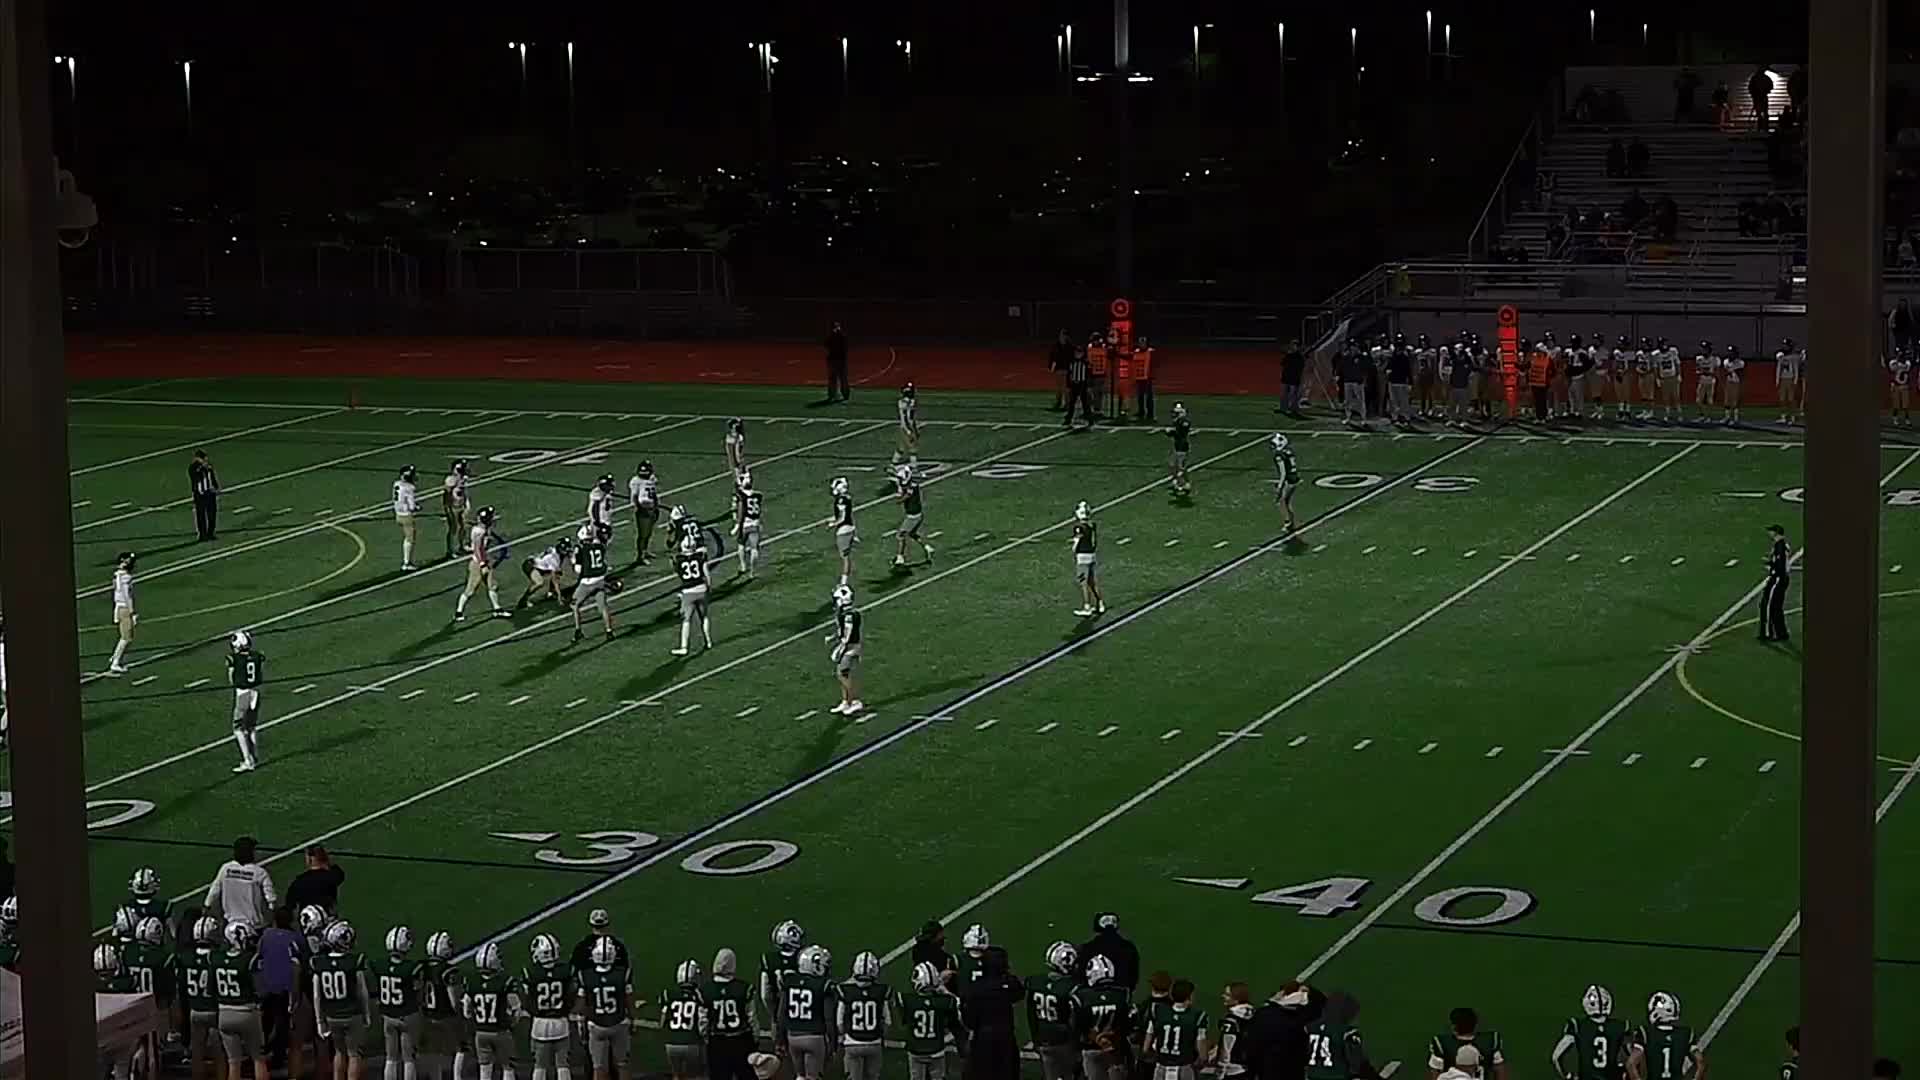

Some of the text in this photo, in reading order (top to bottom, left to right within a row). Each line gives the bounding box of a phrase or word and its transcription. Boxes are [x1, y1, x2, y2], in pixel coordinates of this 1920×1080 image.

[589, 549, 604, 569] 12
[681, 559, 701, 580] 33
[246, 662, 256, 683] 9
[1250, 877, 1534, 925] 40
[187, 968, 213, 998] 54
[216, 968, 241, 998] 65
[322, 971, 348, 1000] 80
[380, 976, 404, 1006] 85
[537, 981, 564, 1011] 22
[474, 993, 498, 1024] 37
[593, 986, 618, 1015] 15
[670, 1000, 697, 1031] 39
[713, 999, 741, 1031] 79
[788, 987, 814, 1021] 52
[852, 1000, 878, 1031] 20
[1033, 993, 1059, 1022] 36
[913, 1009, 938, 1040] 31
[1159, 1024, 1182, 1056] 11
[1308, 1033, 1334, 1068] 74
[1592, 1036, 1608, 1069] 3
[1660, 1047, 1672, 1080] 1
